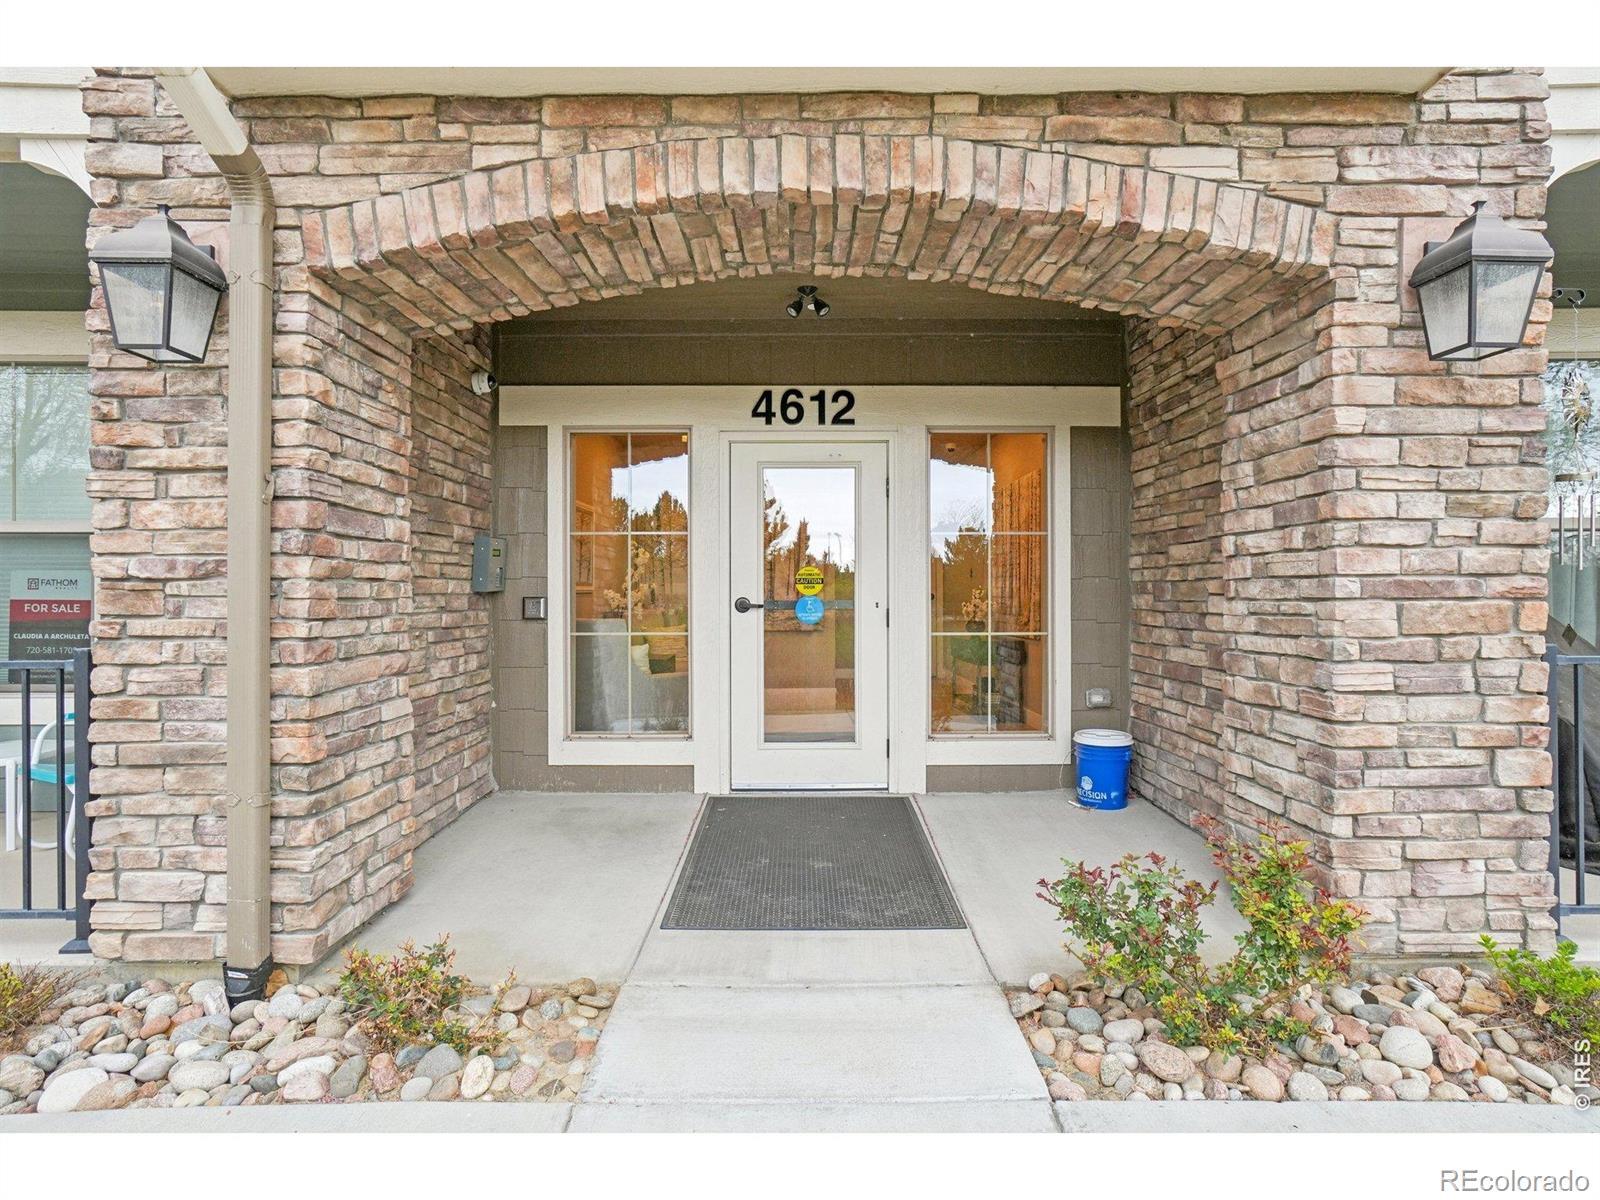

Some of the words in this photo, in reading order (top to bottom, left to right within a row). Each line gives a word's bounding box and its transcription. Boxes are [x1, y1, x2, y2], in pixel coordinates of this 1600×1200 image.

[751, 388, 856, 426] 4612
[40, 578, 78, 587] FATHOM
[24, 603, 49, 613] FOR
[51, 603, 81, 613] SALE
[26, 646, 77, 655] 720-581-170
